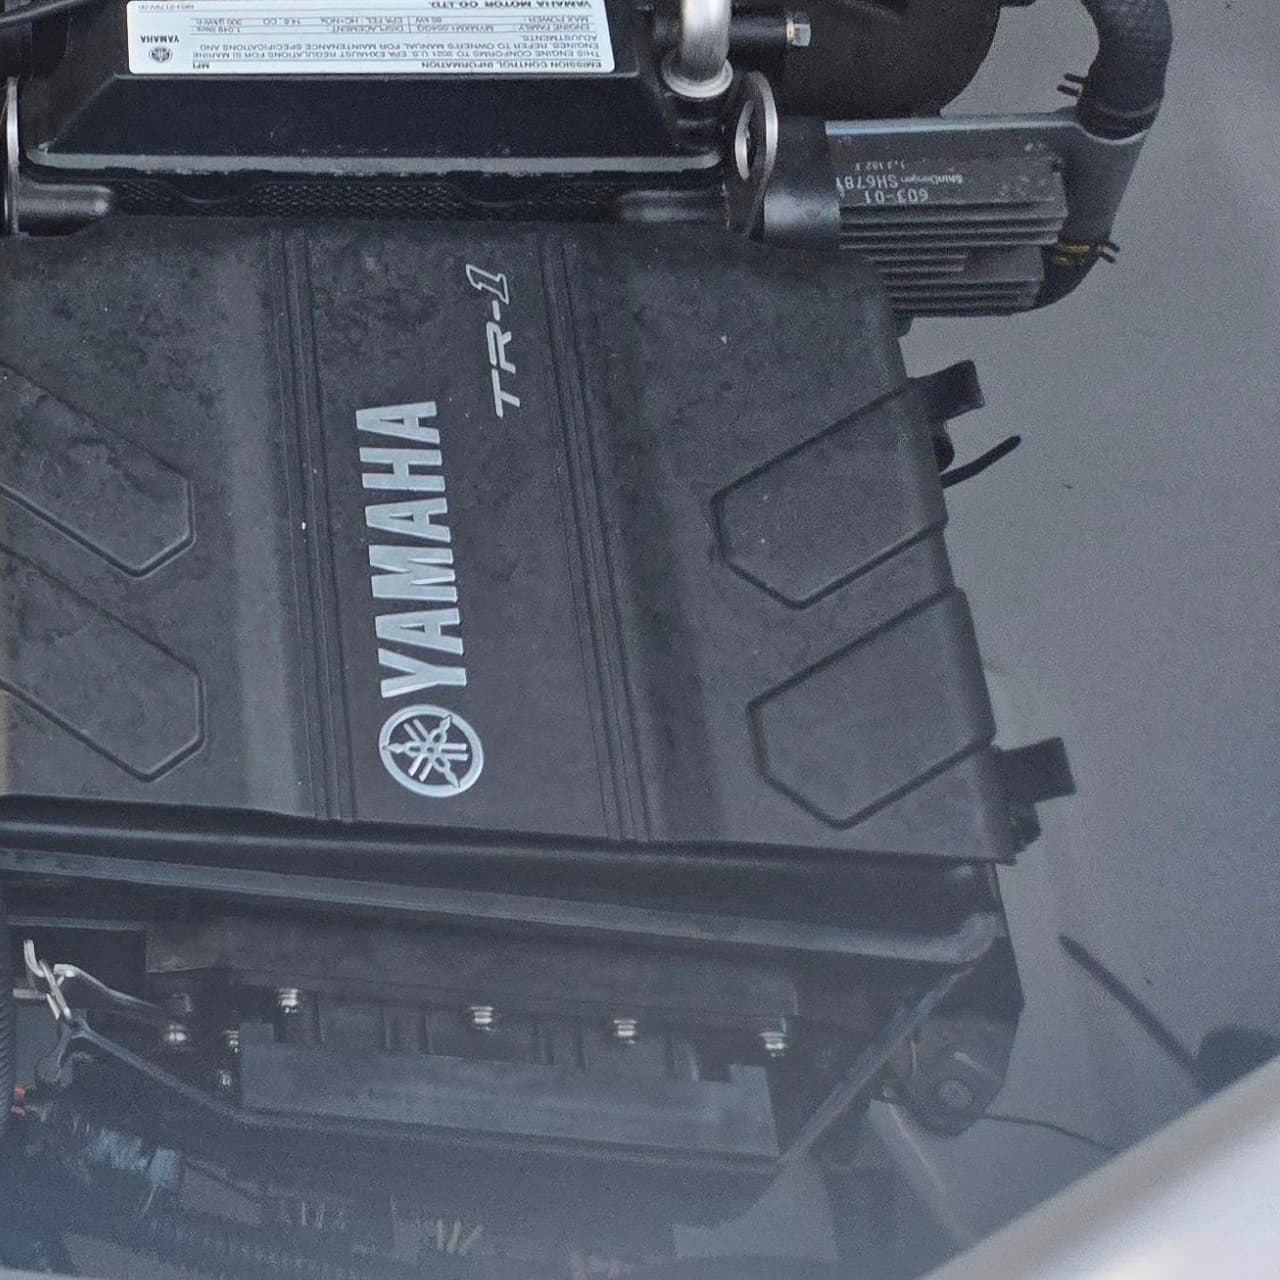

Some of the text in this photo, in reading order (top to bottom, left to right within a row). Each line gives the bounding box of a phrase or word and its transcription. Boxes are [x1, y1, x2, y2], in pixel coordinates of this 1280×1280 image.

[484, 0, 531, 8] MOTOR
[535, 0, 592, 8] YAMAHA
[140, 35, 180, 43] YAMAHA
[464, 263, 521, 419] TR-1
[355, 400, 468, 699] YAMAHA
